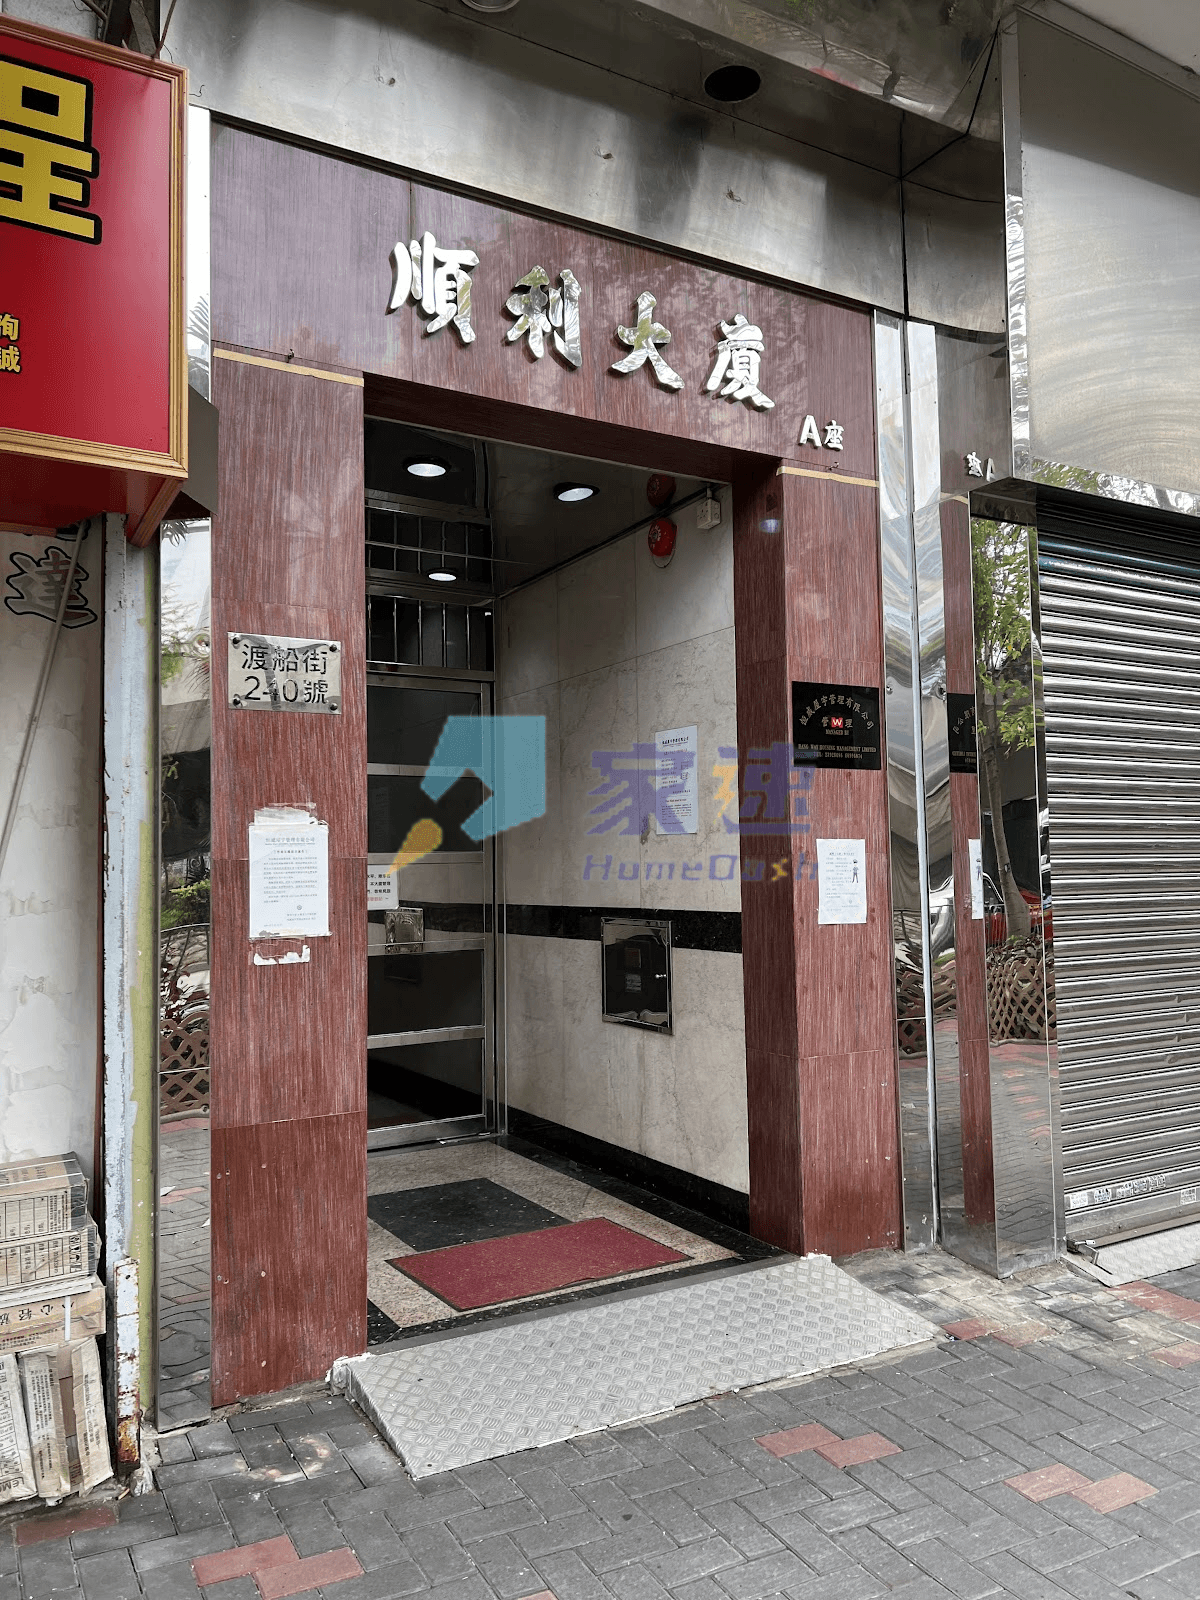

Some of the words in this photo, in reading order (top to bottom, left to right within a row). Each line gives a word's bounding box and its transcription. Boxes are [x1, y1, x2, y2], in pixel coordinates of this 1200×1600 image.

[386, 230, 776, 409] 順利大廈
[798, 414, 845, 451] A座
[241, 643, 328, 675] 渡船街
[244, 675, 329, 704] 240號
